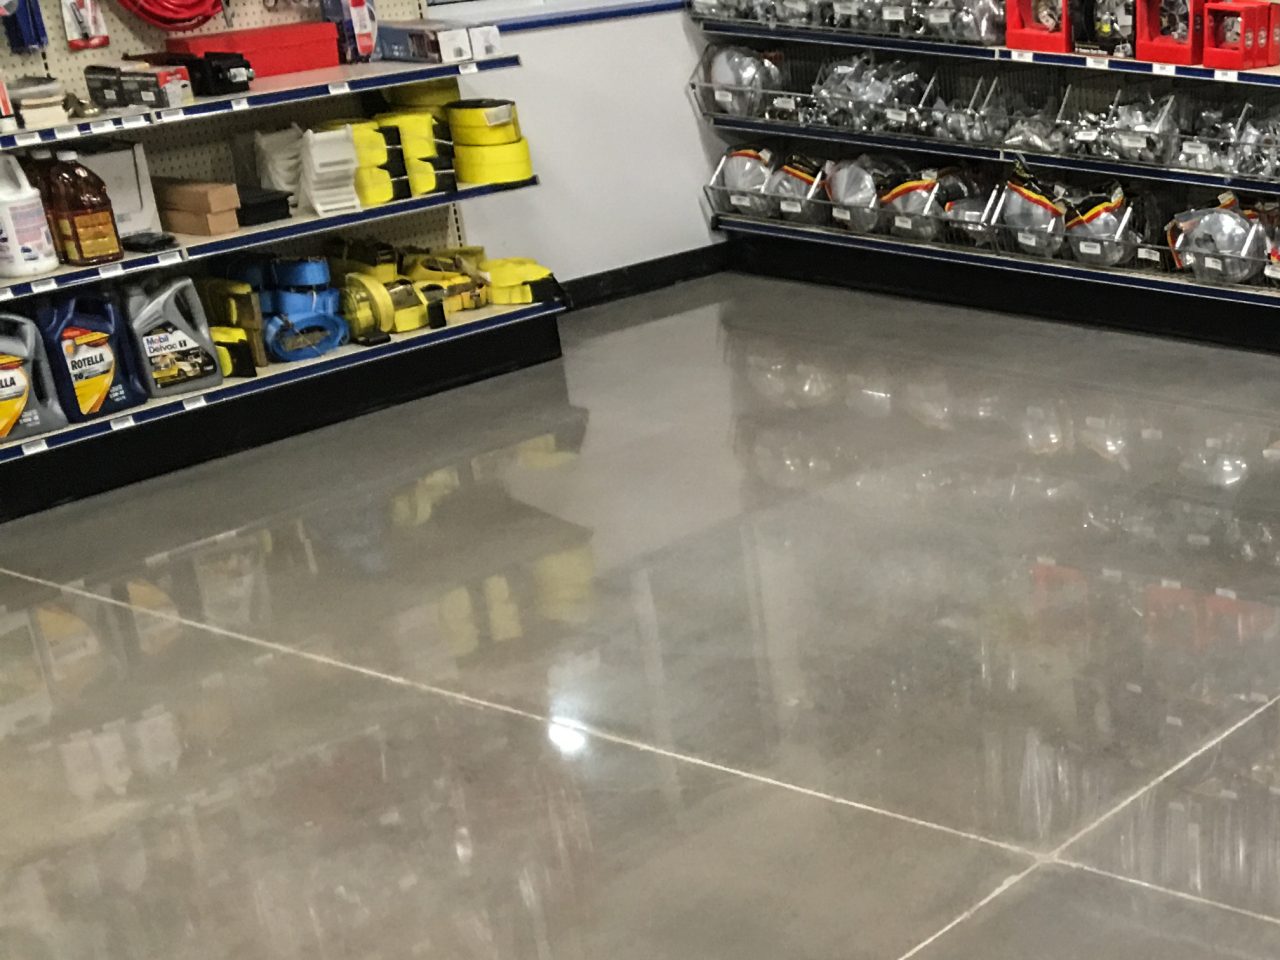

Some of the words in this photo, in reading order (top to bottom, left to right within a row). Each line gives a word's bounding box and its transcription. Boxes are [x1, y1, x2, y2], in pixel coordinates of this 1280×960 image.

[146, 335, 169, 345] Mobil
[148, 343, 178, 354] Delvac
[70, 353, 105, 370] ROTELLA
